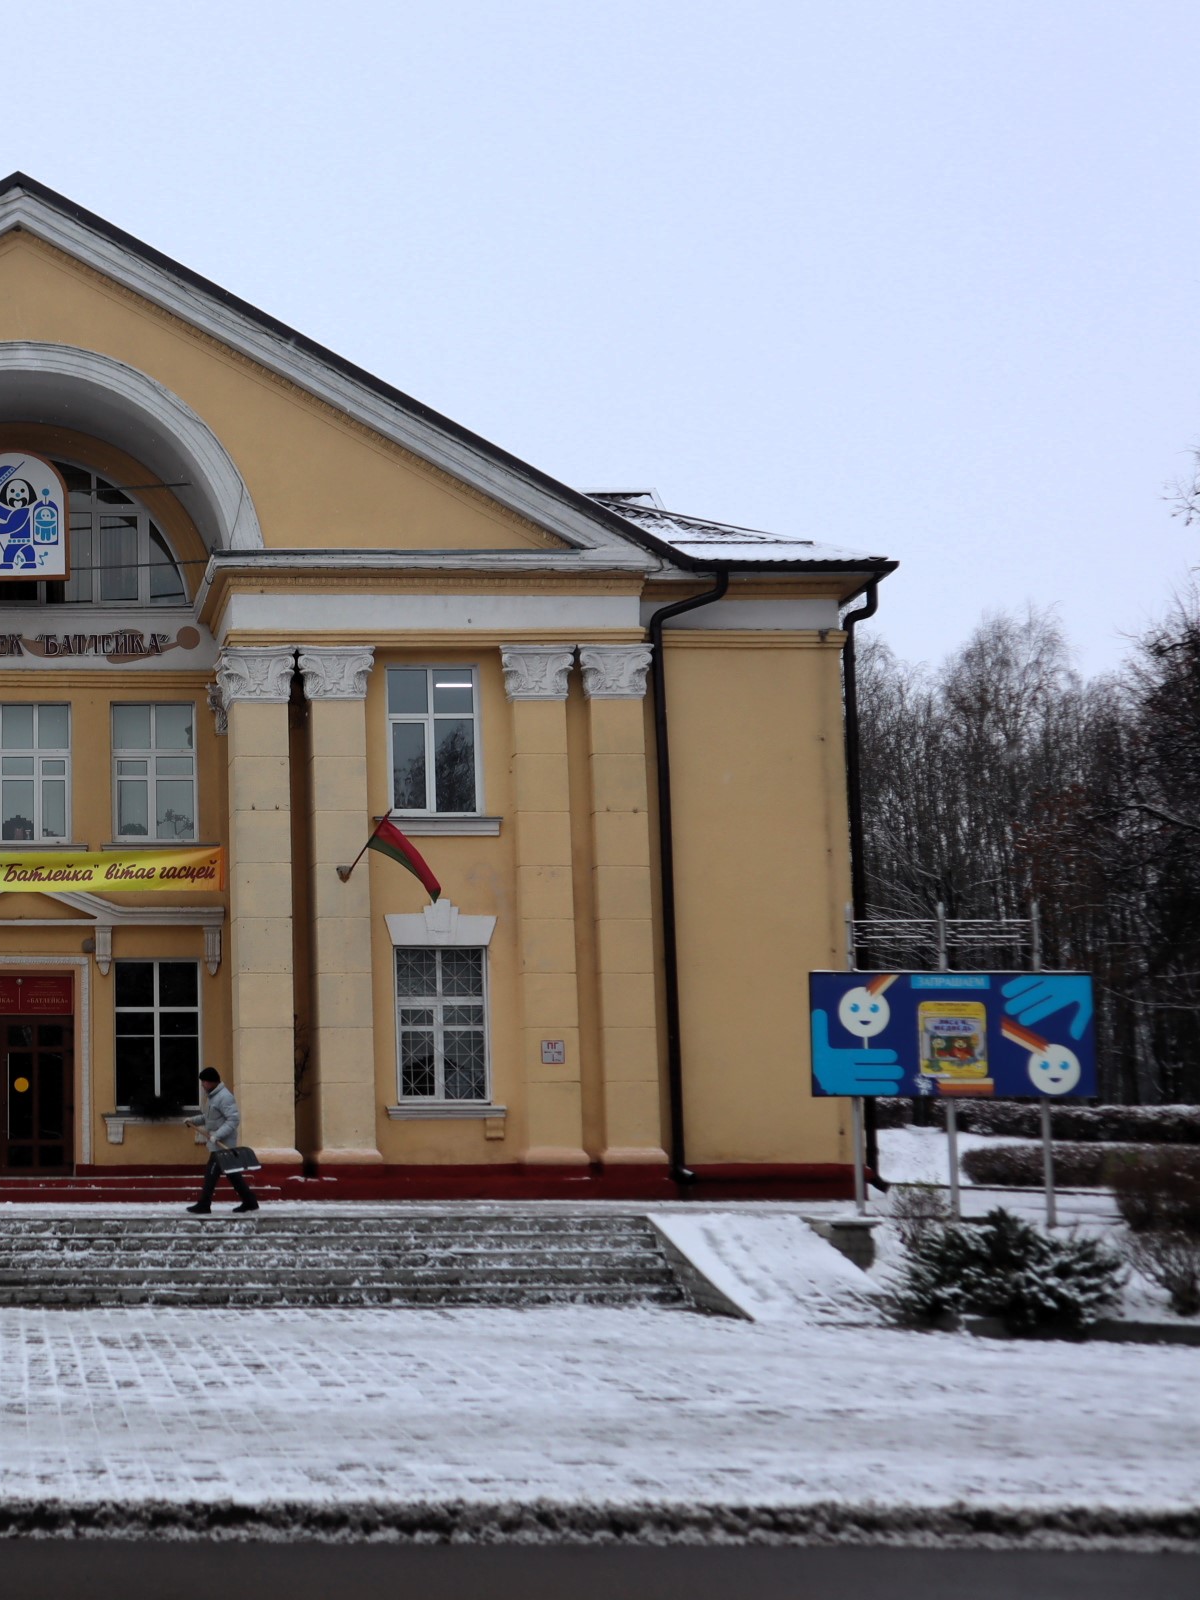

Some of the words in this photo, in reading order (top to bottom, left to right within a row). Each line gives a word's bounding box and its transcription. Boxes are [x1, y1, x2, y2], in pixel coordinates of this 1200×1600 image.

[104, 862, 156, 880] вітае
[159, 859, 218, 883] гасцей
[547, 1042, 559, 1050] ПГ
